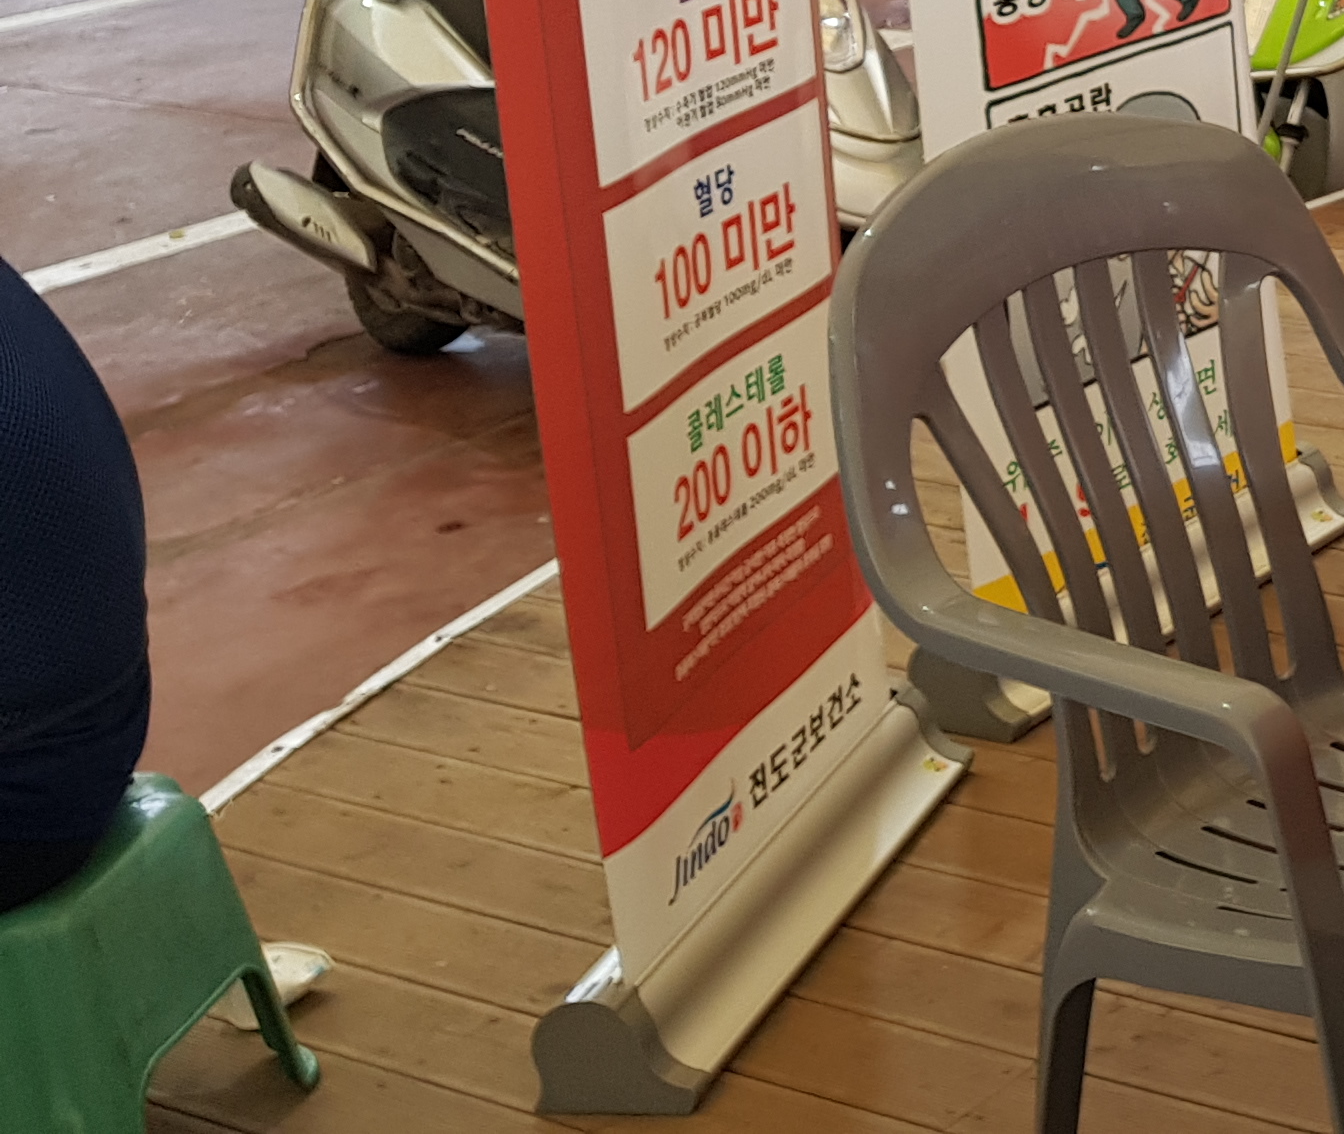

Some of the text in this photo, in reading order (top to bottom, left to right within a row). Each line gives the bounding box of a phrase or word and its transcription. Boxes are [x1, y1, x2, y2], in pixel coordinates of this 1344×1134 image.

[632, 17, 693, 103] 120
[655, 181, 796, 320] 100 미만
[693, 163, 735, 219] 혈당
[673, 382, 813, 543] 200 이하
[687, 353, 786, 454] 콜레스테롤
[746, 672, 863, 810] 진도군보건소
